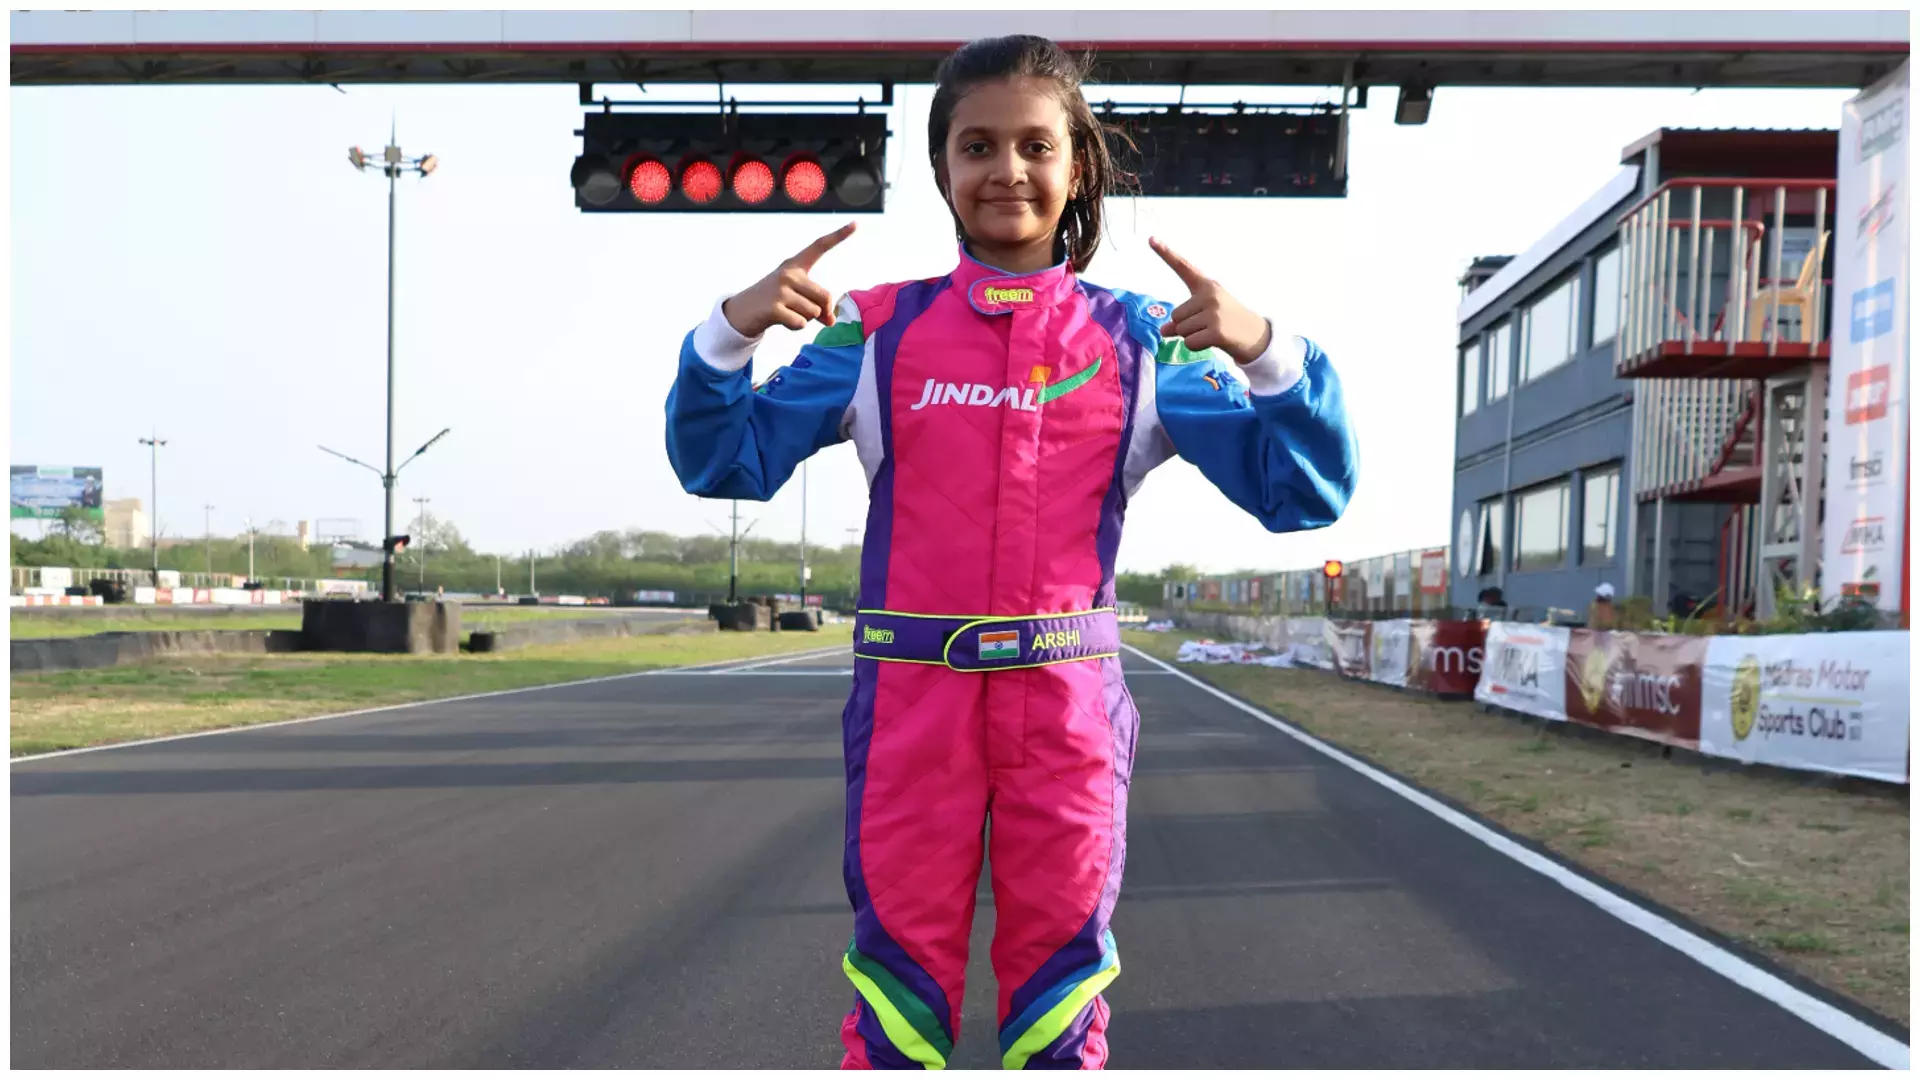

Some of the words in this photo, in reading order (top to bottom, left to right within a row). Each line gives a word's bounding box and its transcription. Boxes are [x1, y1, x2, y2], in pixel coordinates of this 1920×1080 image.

[985, 287, 1034, 305] freem
[911, 378, 1037, 412] JINDAL
[863, 624, 894, 644] freem
[1032, 630, 1080, 650] ARSHI
[1817, 660, 1871, 691] Motor
[1758, 703, 1804, 740] Sports
[1808, 707, 1846, 740] Club
